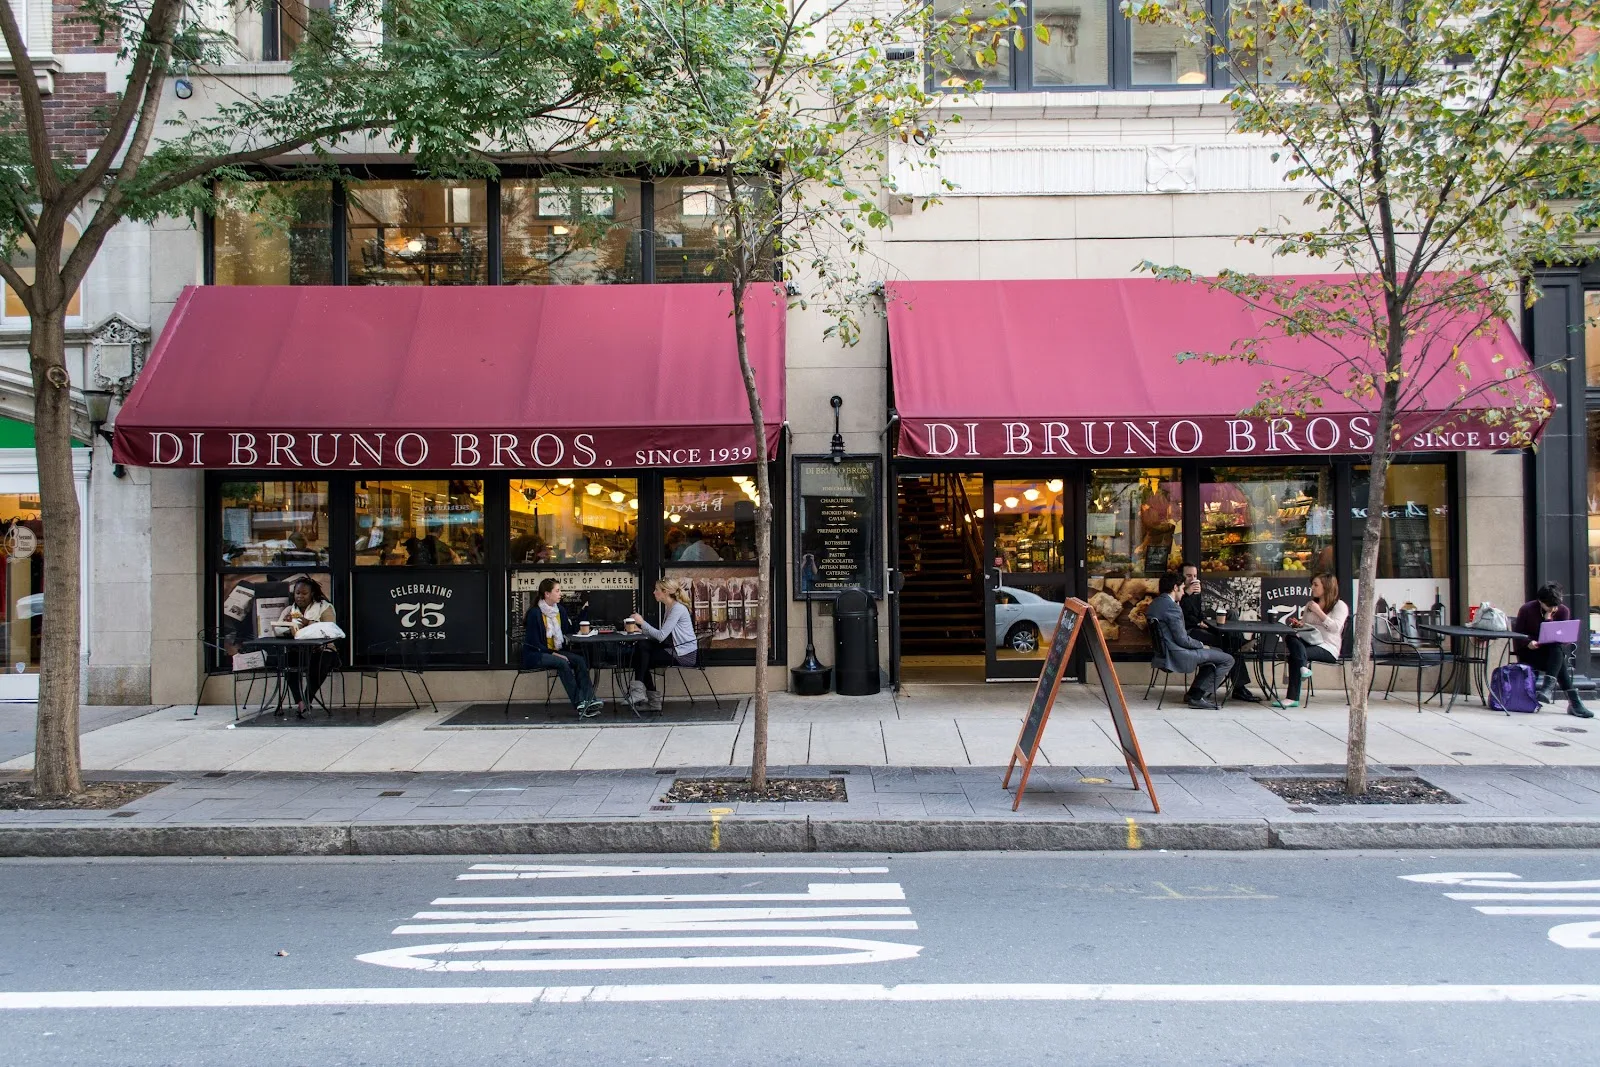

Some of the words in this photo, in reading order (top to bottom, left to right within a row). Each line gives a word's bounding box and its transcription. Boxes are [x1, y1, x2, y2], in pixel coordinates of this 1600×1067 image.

[923, 422, 981, 456] DI
[1002, 420, 1204, 456] BRUNO
[1225, 416, 1390, 453] BROS
[1413, 431, 1481, 448] SINCE
[149, 431, 205, 466] DI
[228, 431, 429, 467] BRUNO
[451, 432, 613, 467] BROS.
[635, 449, 702, 465] SINCE
[708, 446, 752, 462] 1939
[815, 467, 844, 475] BRUNO
[390, 583, 453, 599] CELEBRATING
[1266, 586, 1312, 600] CELEBRAT
[395, 602, 446, 628] 75
[1271, 604, 1306, 626] 7
[400, 631, 446, 640] YEARS
